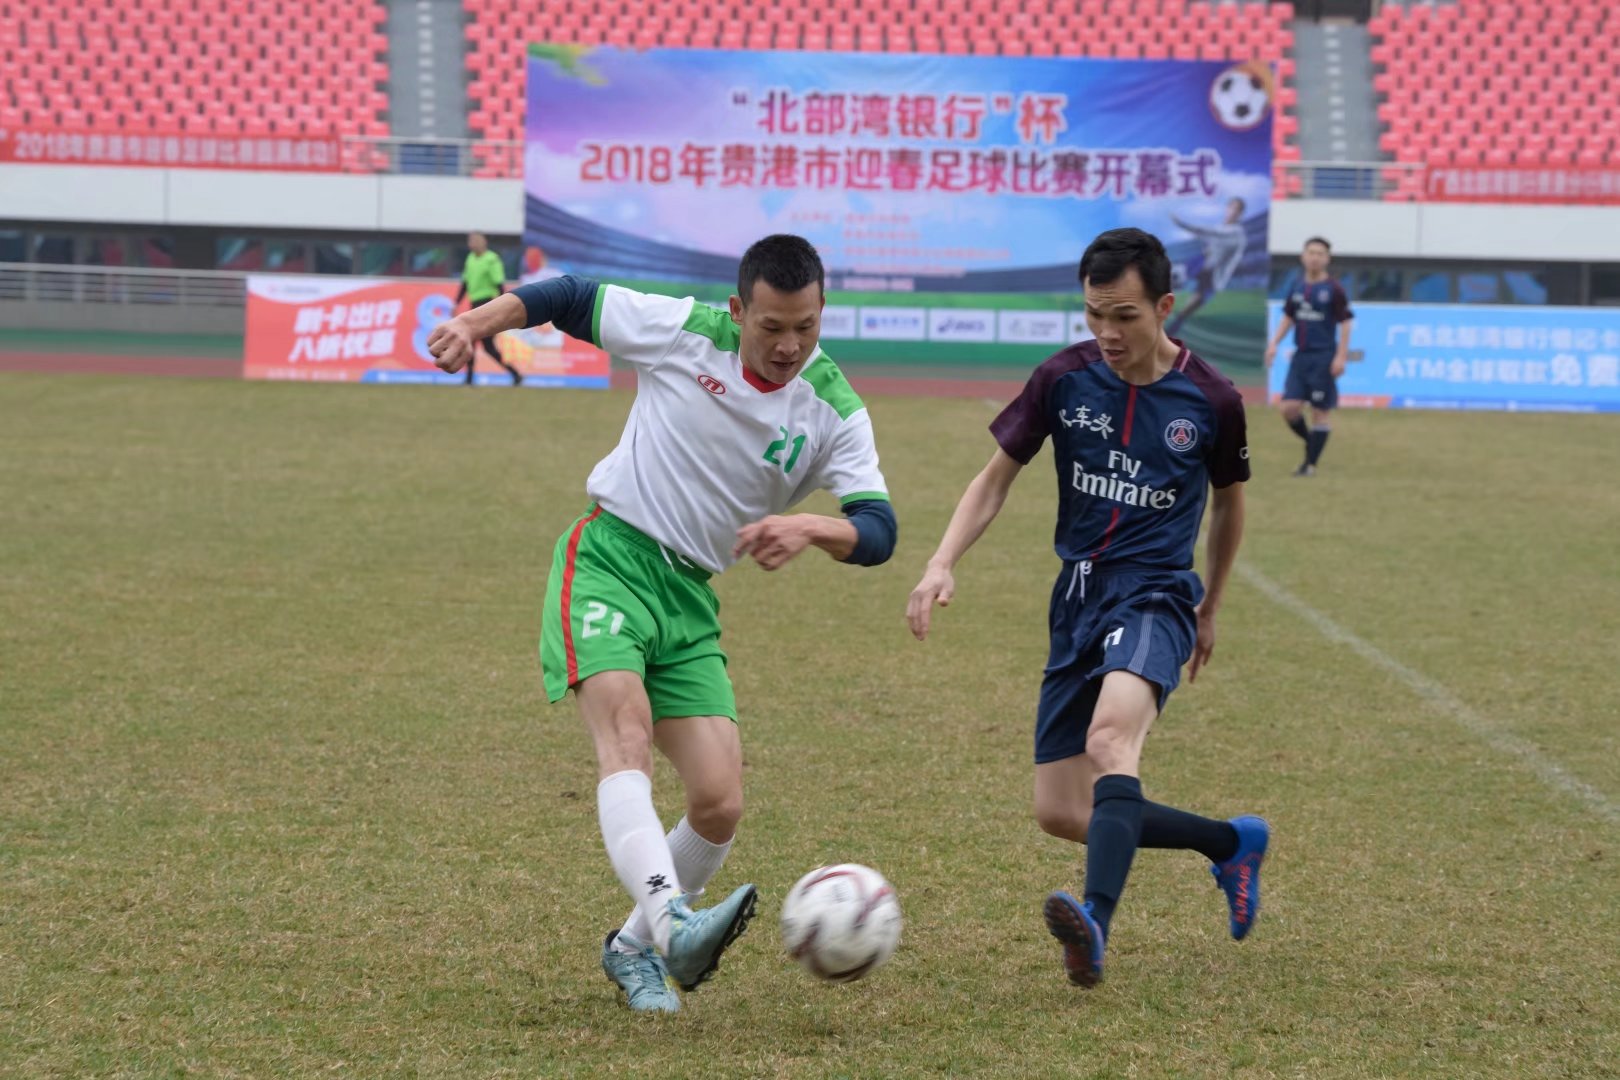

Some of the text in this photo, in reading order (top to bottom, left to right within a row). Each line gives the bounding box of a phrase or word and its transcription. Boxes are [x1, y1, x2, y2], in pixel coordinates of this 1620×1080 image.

[580, 145, 1215, 196] 2018年贵港市迎春足球比赛开幕式
[763, 426, 806, 474] 21
[1107, 449, 1142, 478] Fly
[1072, 461, 1177, 511] Emirates
[581, 601, 625, 639] 21
